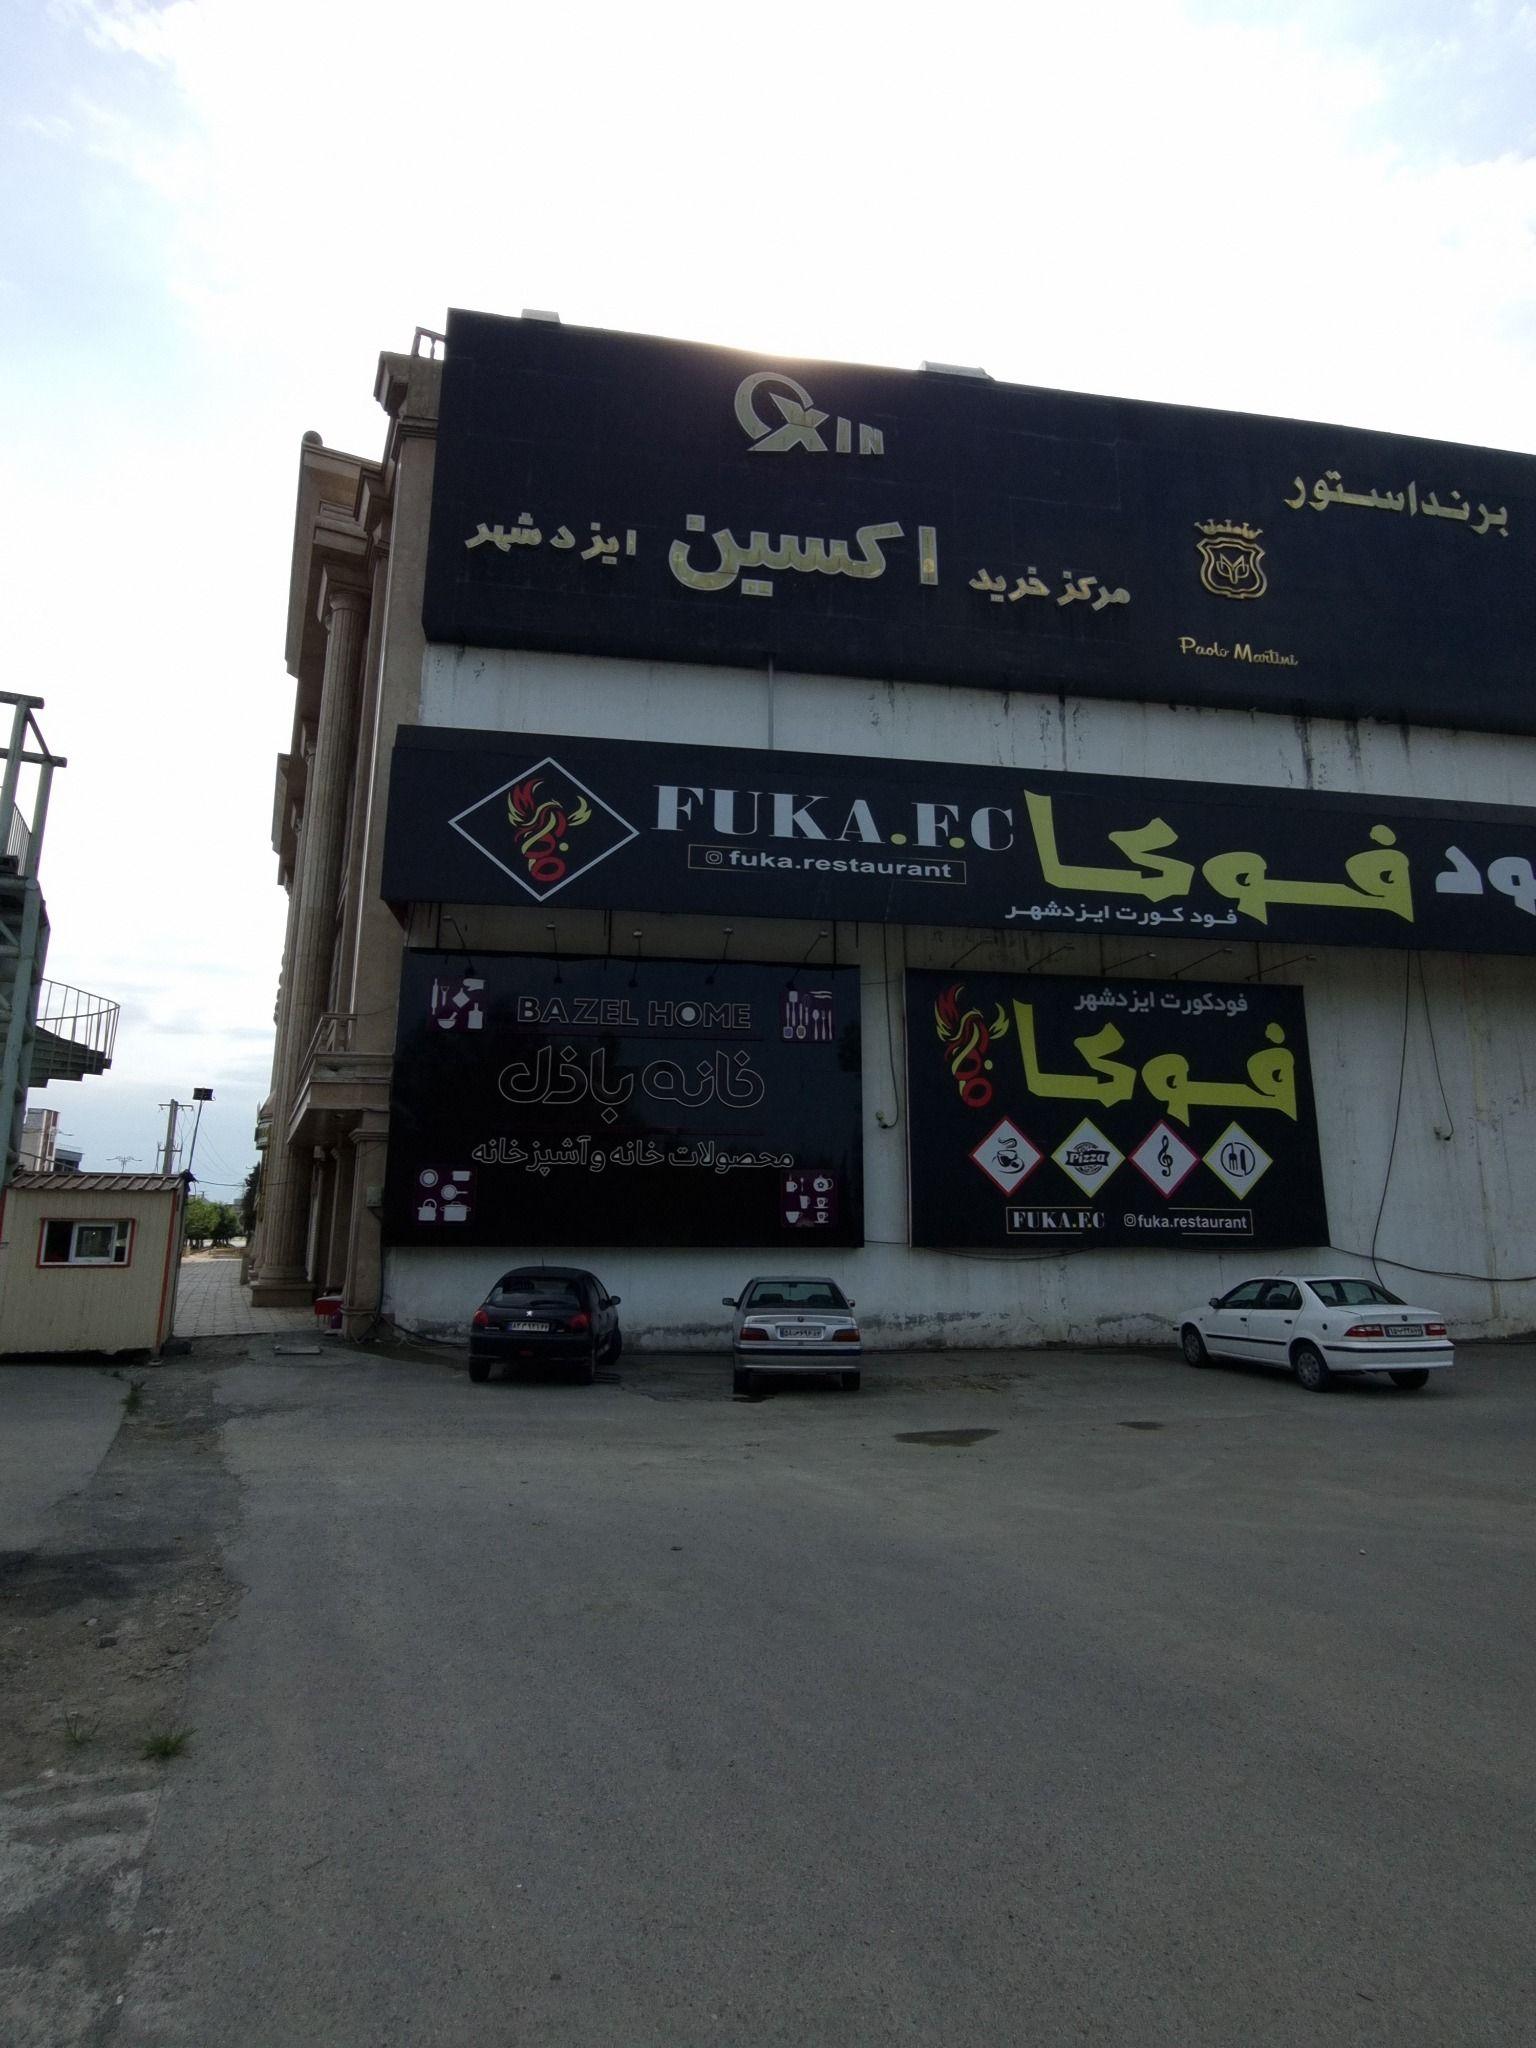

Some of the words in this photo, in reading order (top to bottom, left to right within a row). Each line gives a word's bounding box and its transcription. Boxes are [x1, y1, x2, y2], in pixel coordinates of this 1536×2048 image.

[669, 514, 938, 598] اکسین
[968, 567, 1051, 603] خرید
[1056, 570, 1131, 611] مرکز
[1178, 637, 1230, 659] Paolo
[1233, 642, 1299, 666] Martini
[728, 848, 953, 879] fuka.restaurant
[1023, 788, 1415, 927] فوکا
[516, 994, 641, 1026] BAZEL
[647, 1000, 752, 1029] HOME
[641, 1049, 766, 1109] خانه
[1012, 998, 1298, 1128] فوکا
[609, 1138, 666, 1167] خانه
[668, 1140, 796, 1175] محصولات
[1068, 1151, 1107, 1165] Pizza
[1137, 1213, 1248, 1230] fuka.restaurant
